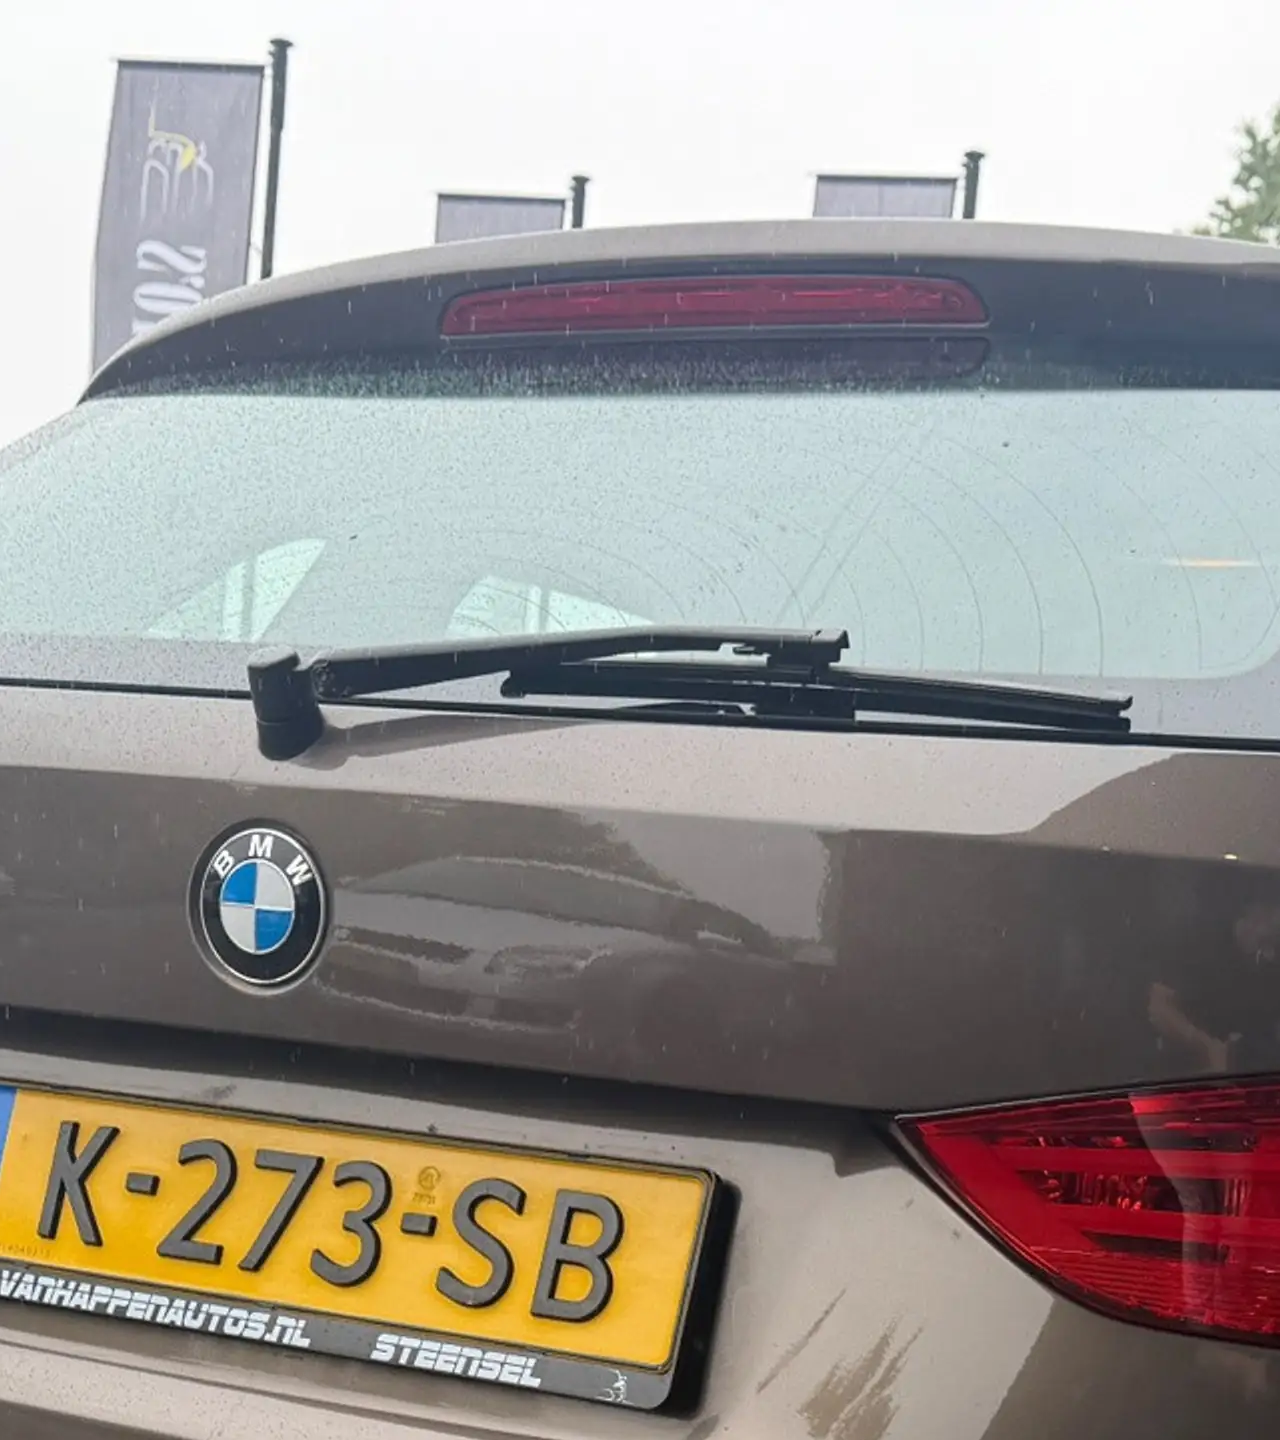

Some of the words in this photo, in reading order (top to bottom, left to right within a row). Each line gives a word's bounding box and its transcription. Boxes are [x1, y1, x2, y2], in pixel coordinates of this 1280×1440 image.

[213, 834, 313, 887] BMW
[36, 1121, 625, 1322] K-273-SB
[368, 1333, 543, 1389] STEENSEL
